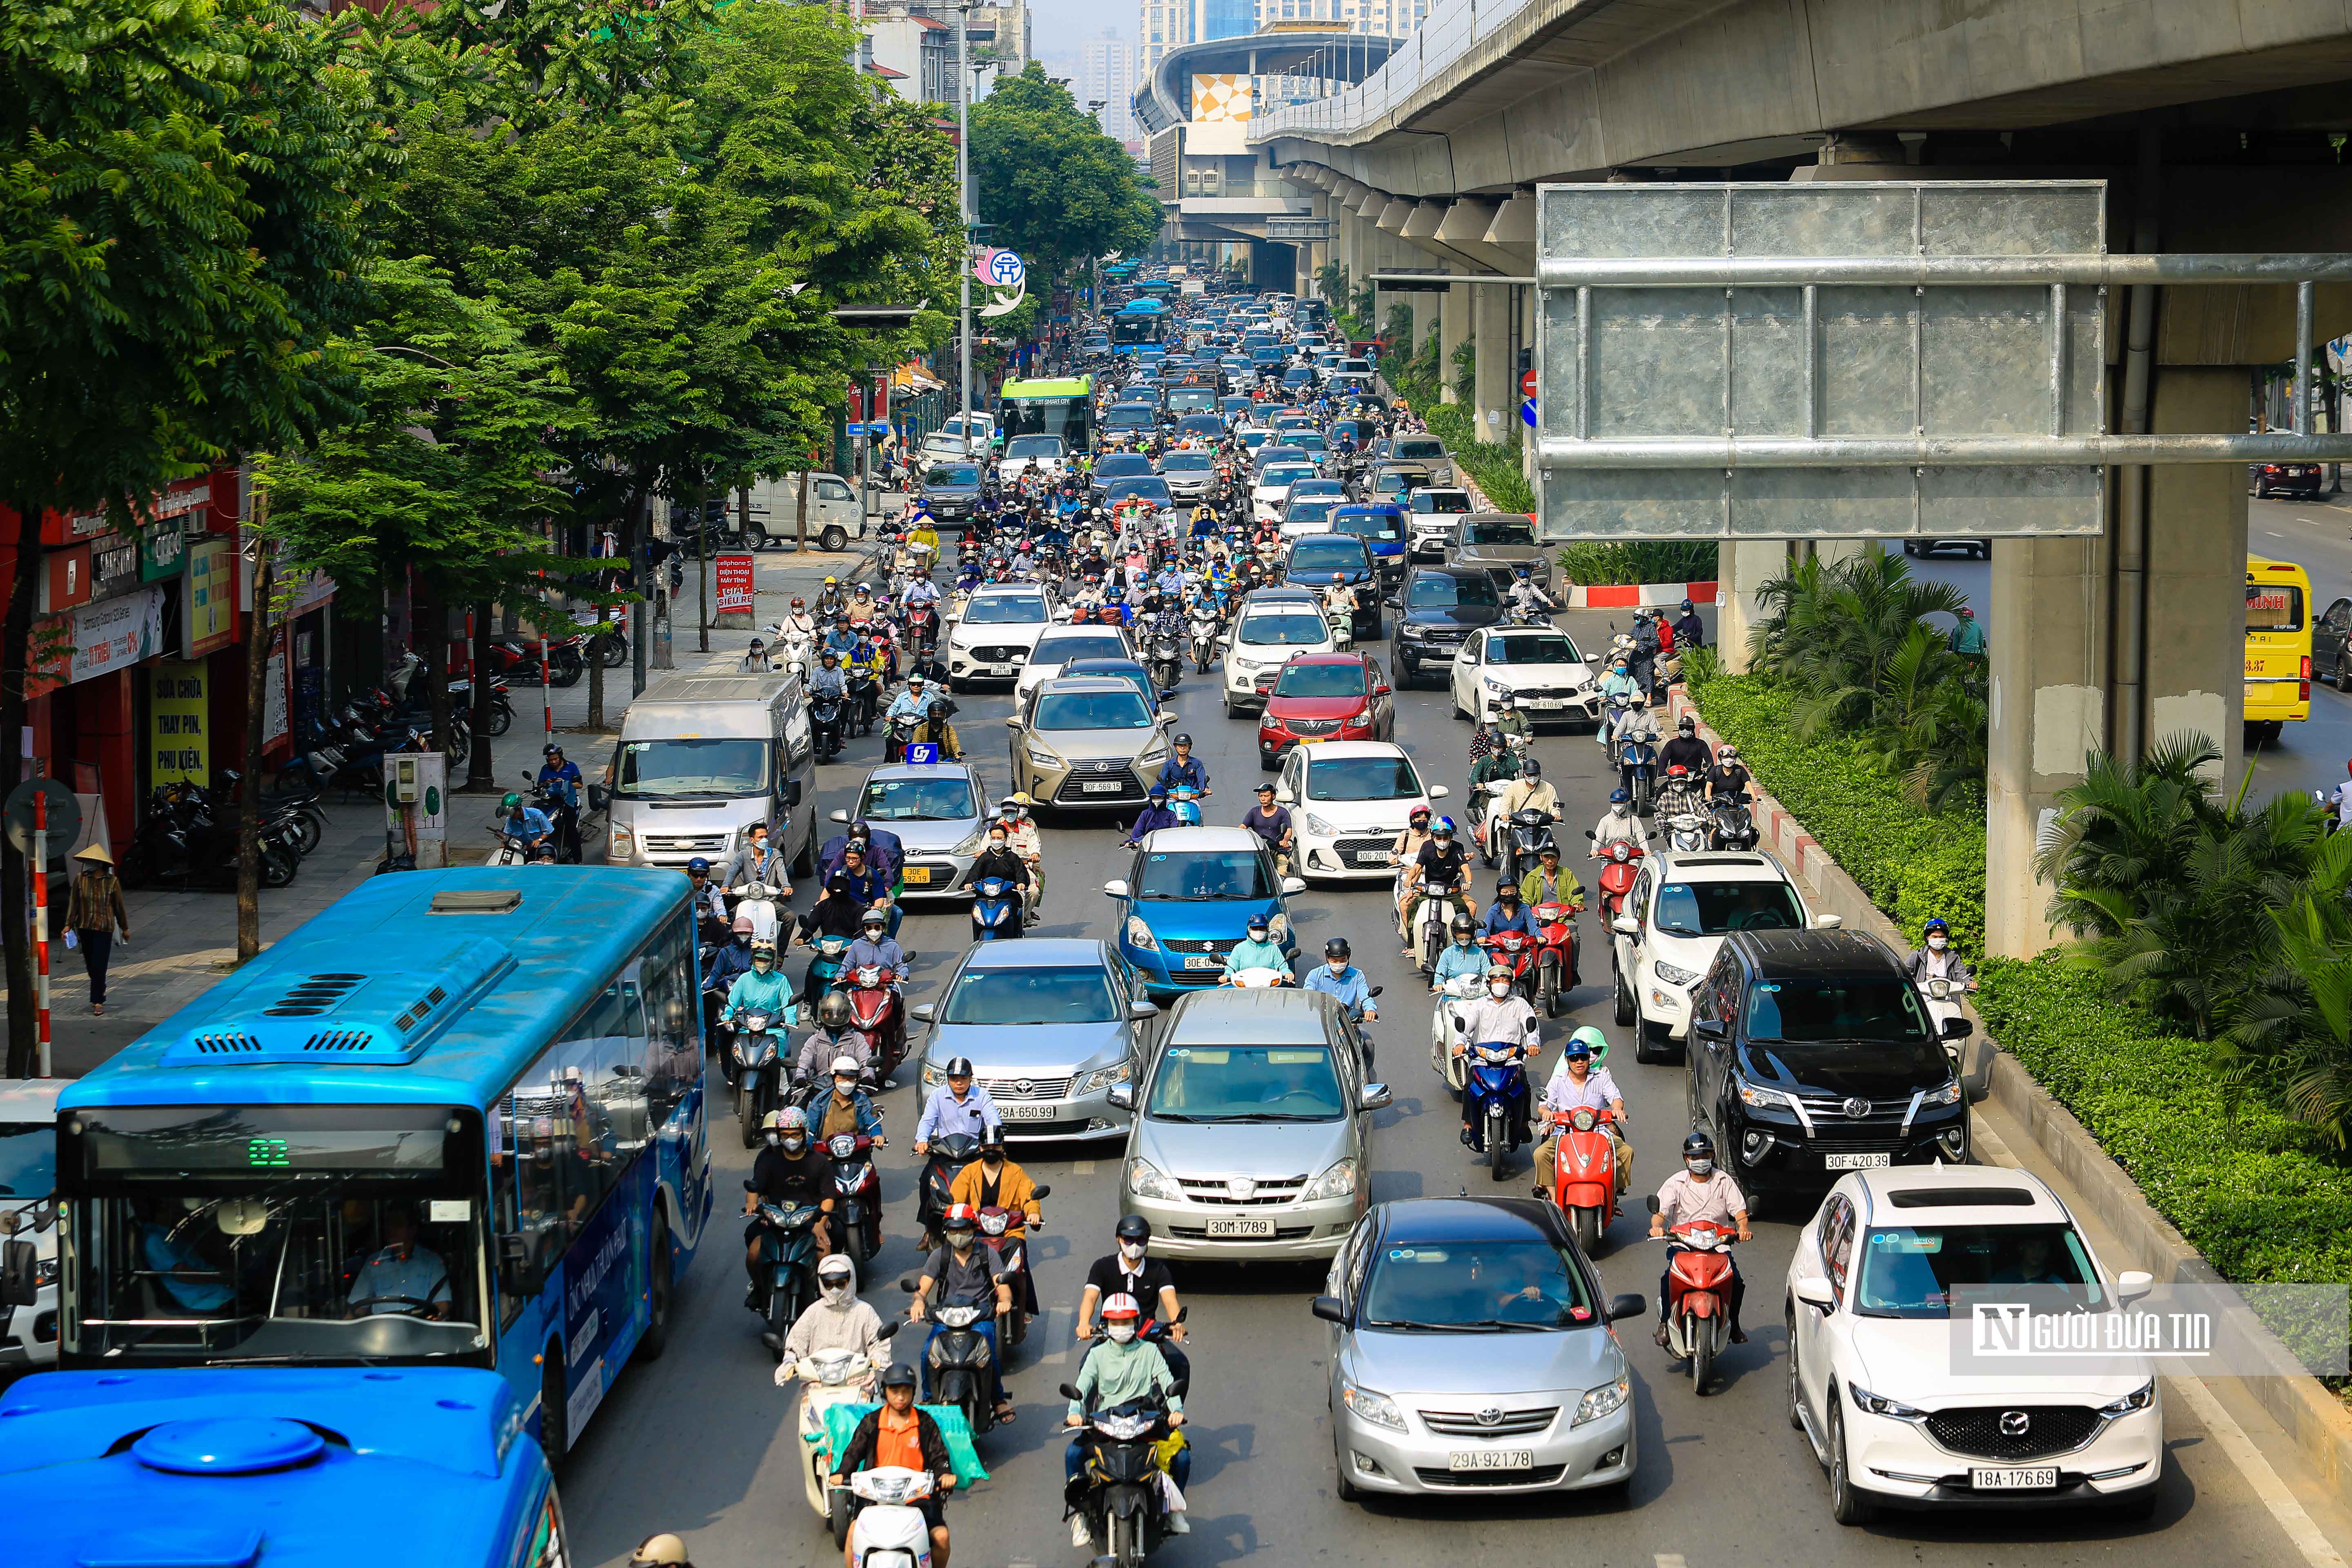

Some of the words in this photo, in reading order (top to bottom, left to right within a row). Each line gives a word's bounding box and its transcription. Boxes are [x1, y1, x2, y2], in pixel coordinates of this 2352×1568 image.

[725, 585, 742, 595] GIÁ
[718, 597, 738, 606] SIÊU
[157, 674, 176, 699] SỬA
[178, 676, 203, 699] CHỮA
[158, 715, 180, 734] THAY
[183, 715, 202, 736] PIN,
[158, 750, 176, 773] PHỤ
[178, 746, 203, 773] KIỆN,
[1212, 1221, 1267, 1233] 30M-1789
